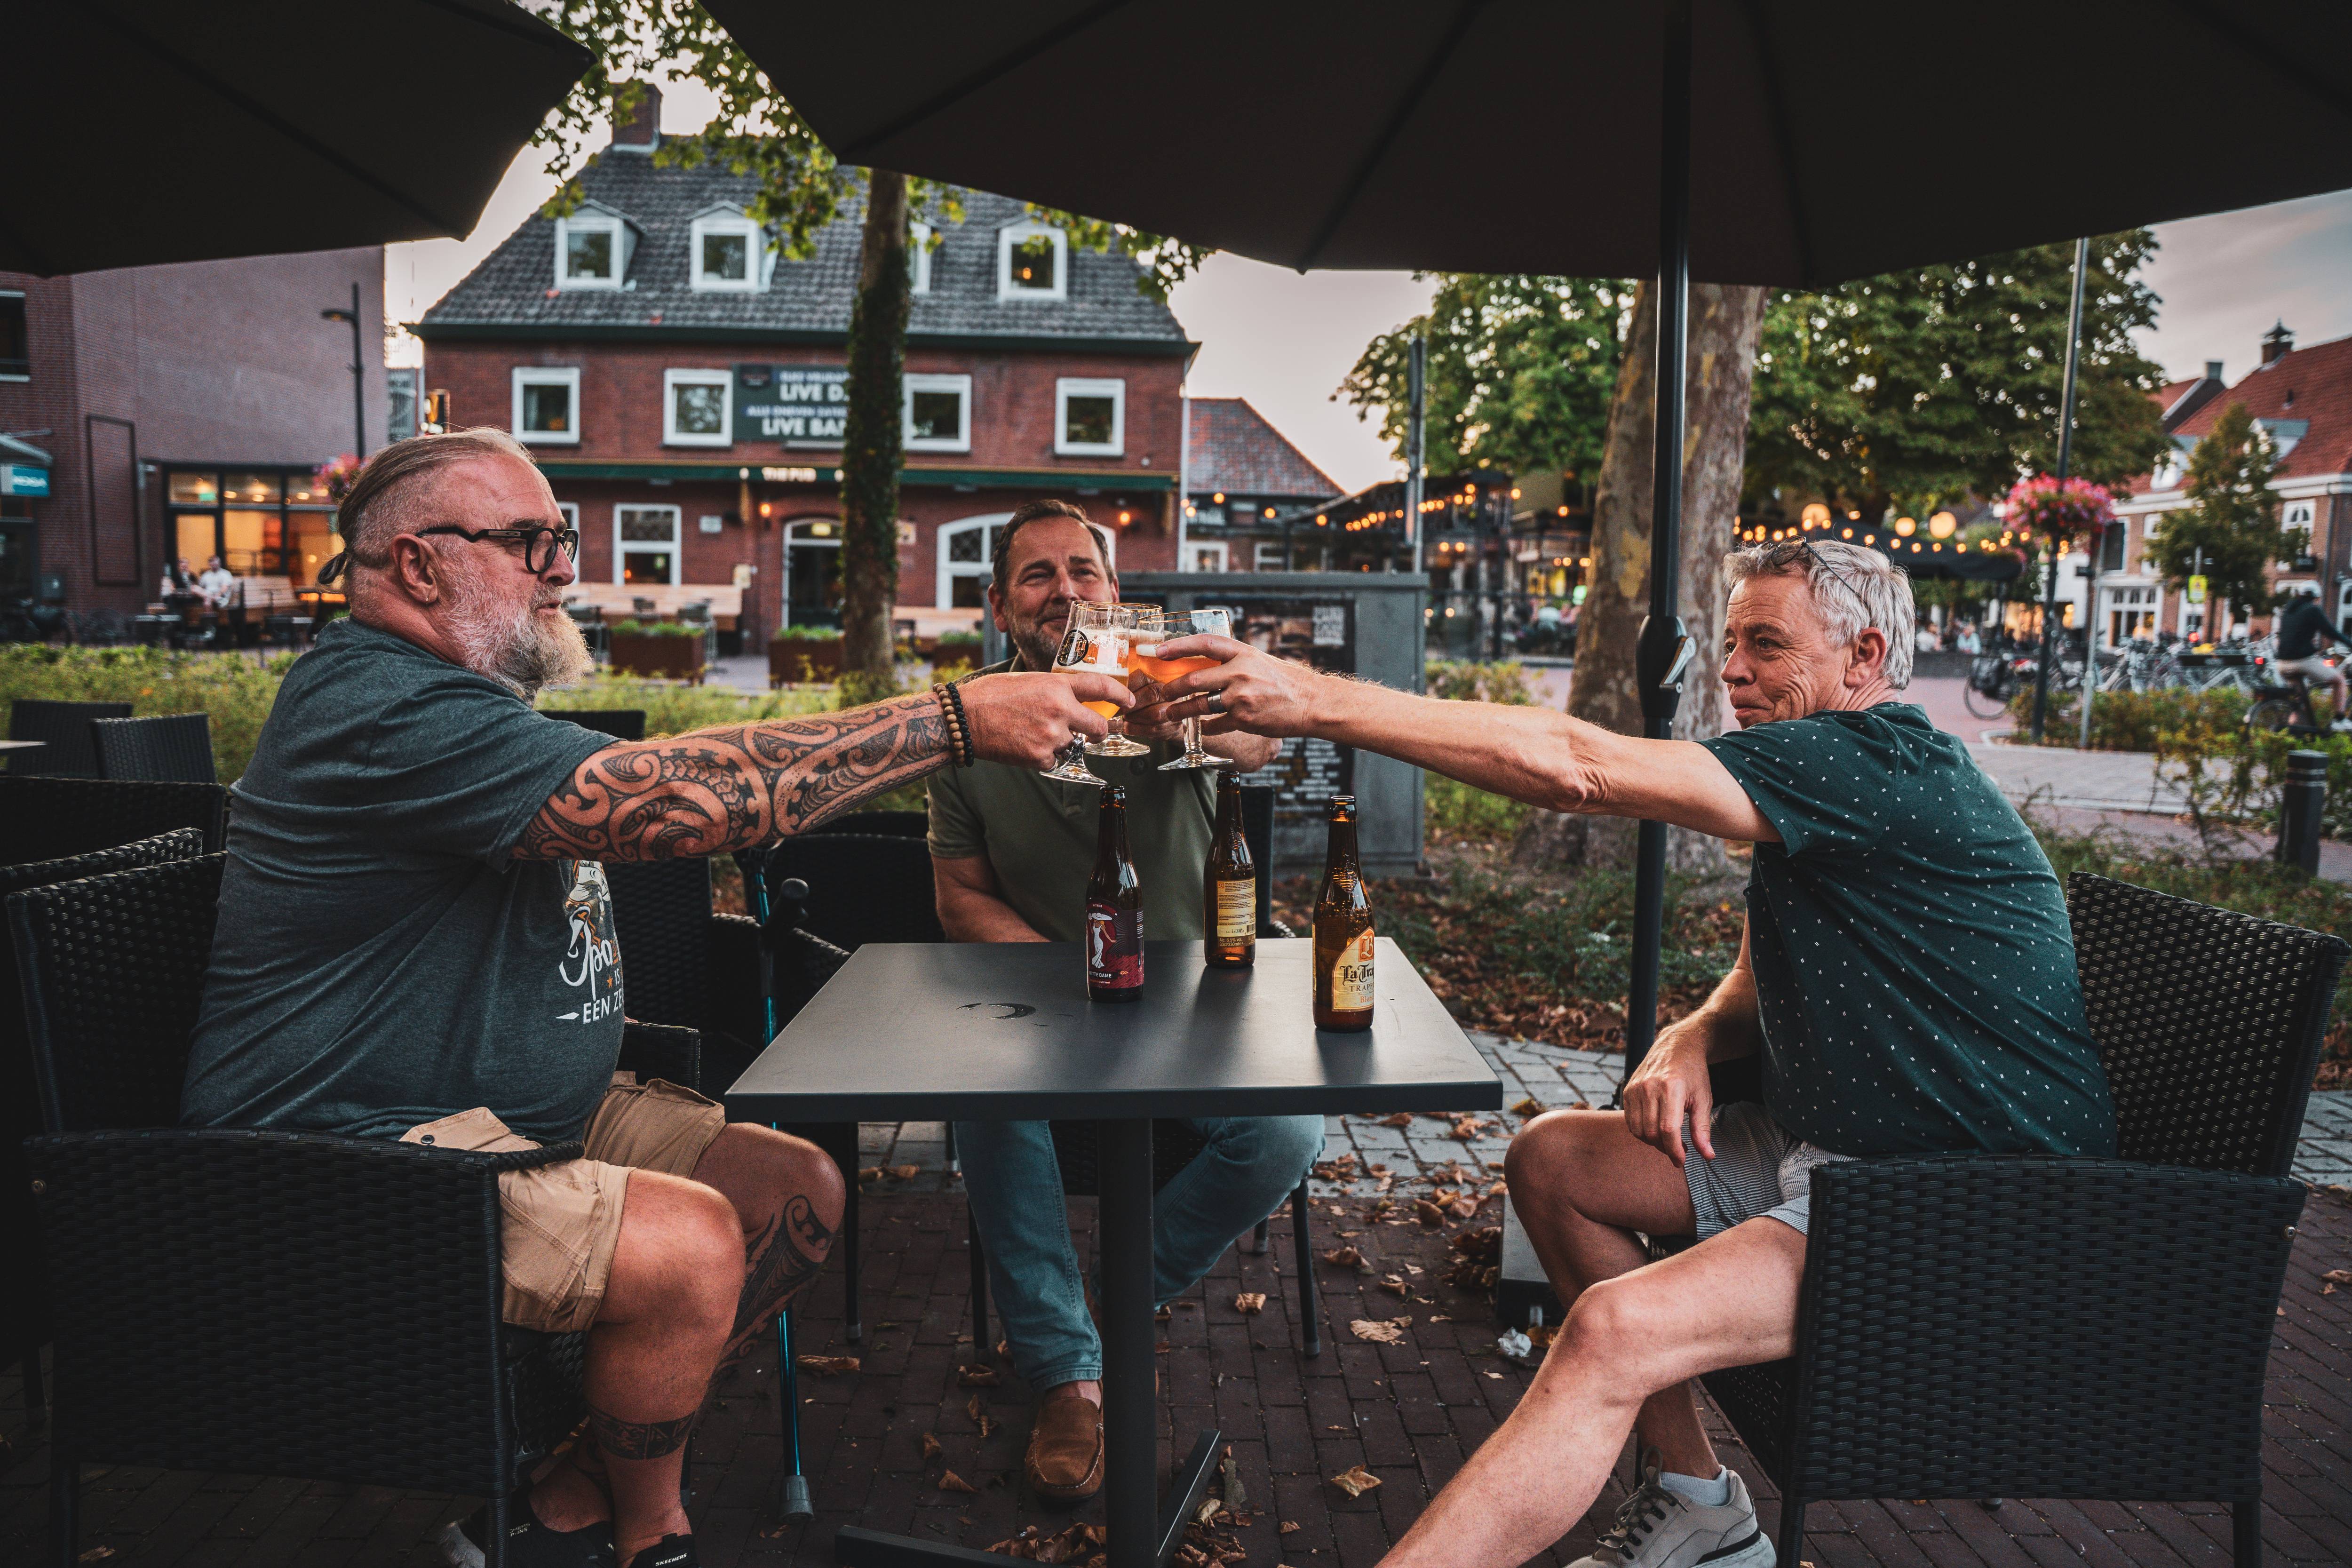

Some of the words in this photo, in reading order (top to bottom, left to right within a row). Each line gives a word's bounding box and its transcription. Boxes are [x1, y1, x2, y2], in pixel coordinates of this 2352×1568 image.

[779, 383, 823, 402] LIVE
[761, 418, 805, 436] LIVE
[1339, 965, 1359, 987] La
[1349, 982, 1375, 992] TRAPP
[583, 995, 610, 1025] EEN
[613, 987, 624, 1013] ZE
[655, 1553, 687, 1566] SKECHERS
